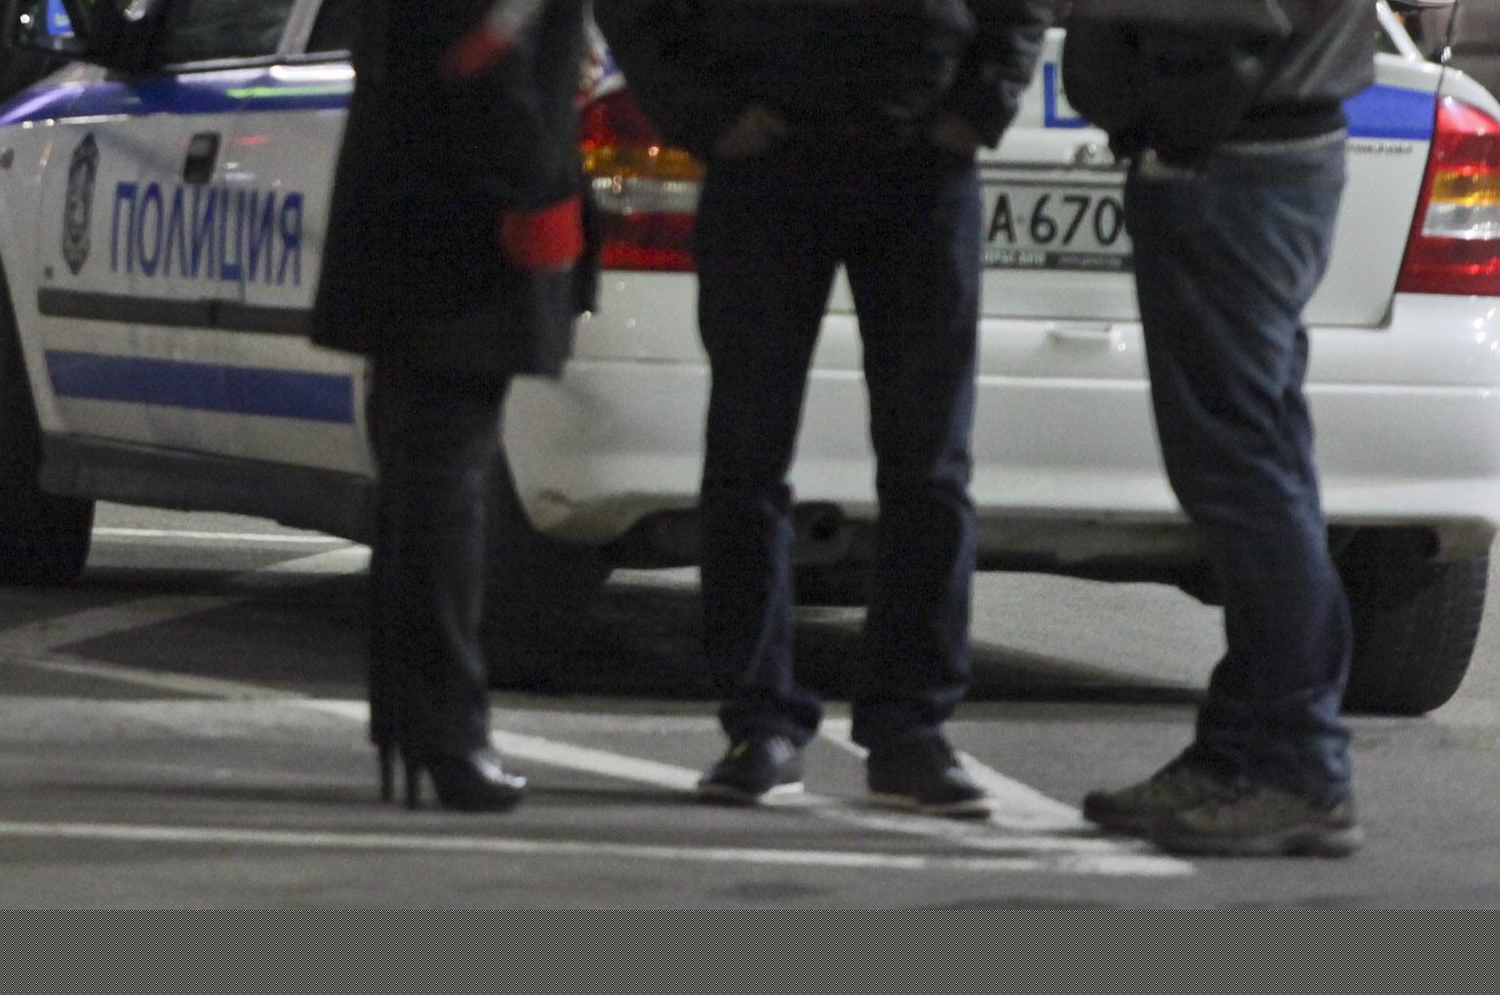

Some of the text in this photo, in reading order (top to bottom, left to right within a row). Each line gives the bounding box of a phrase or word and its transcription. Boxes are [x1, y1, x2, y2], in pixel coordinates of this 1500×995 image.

[111, 181, 304, 295] ПОЛИЦИЯ
[987, 193, 1126, 245] A 670
